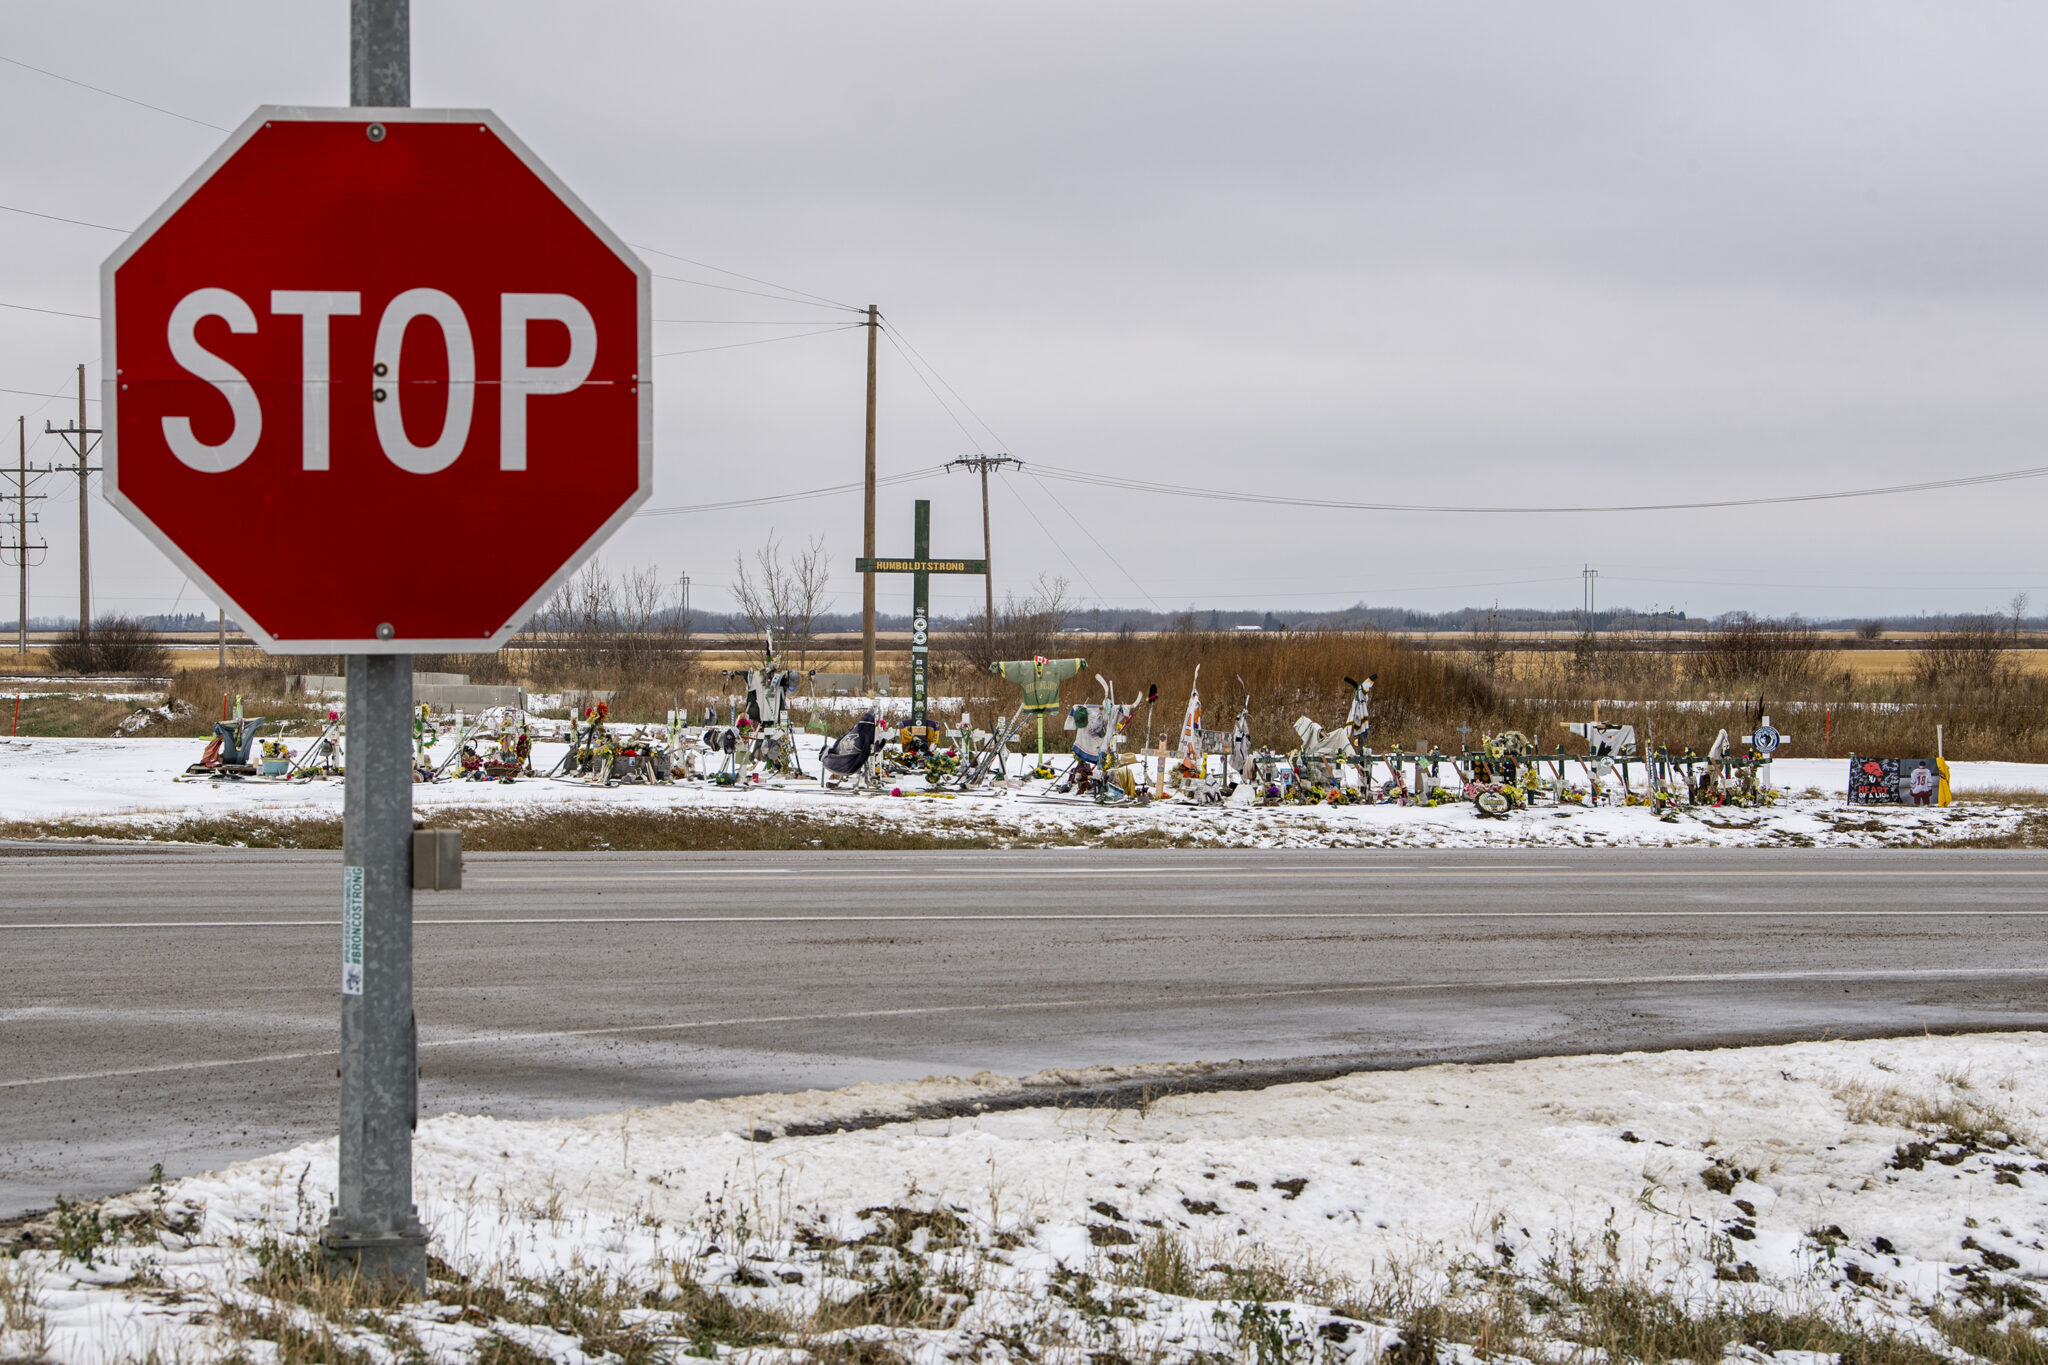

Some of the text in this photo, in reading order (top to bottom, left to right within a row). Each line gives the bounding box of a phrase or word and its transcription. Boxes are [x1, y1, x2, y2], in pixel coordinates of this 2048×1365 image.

[161, 287, 598, 475] STOP
[876, 561, 965, 571] HUMBOLDTSTRONG
[1917, 775, 1926, 785] 18
[352, 867, 363, 964] #BRONCOSTRONG
